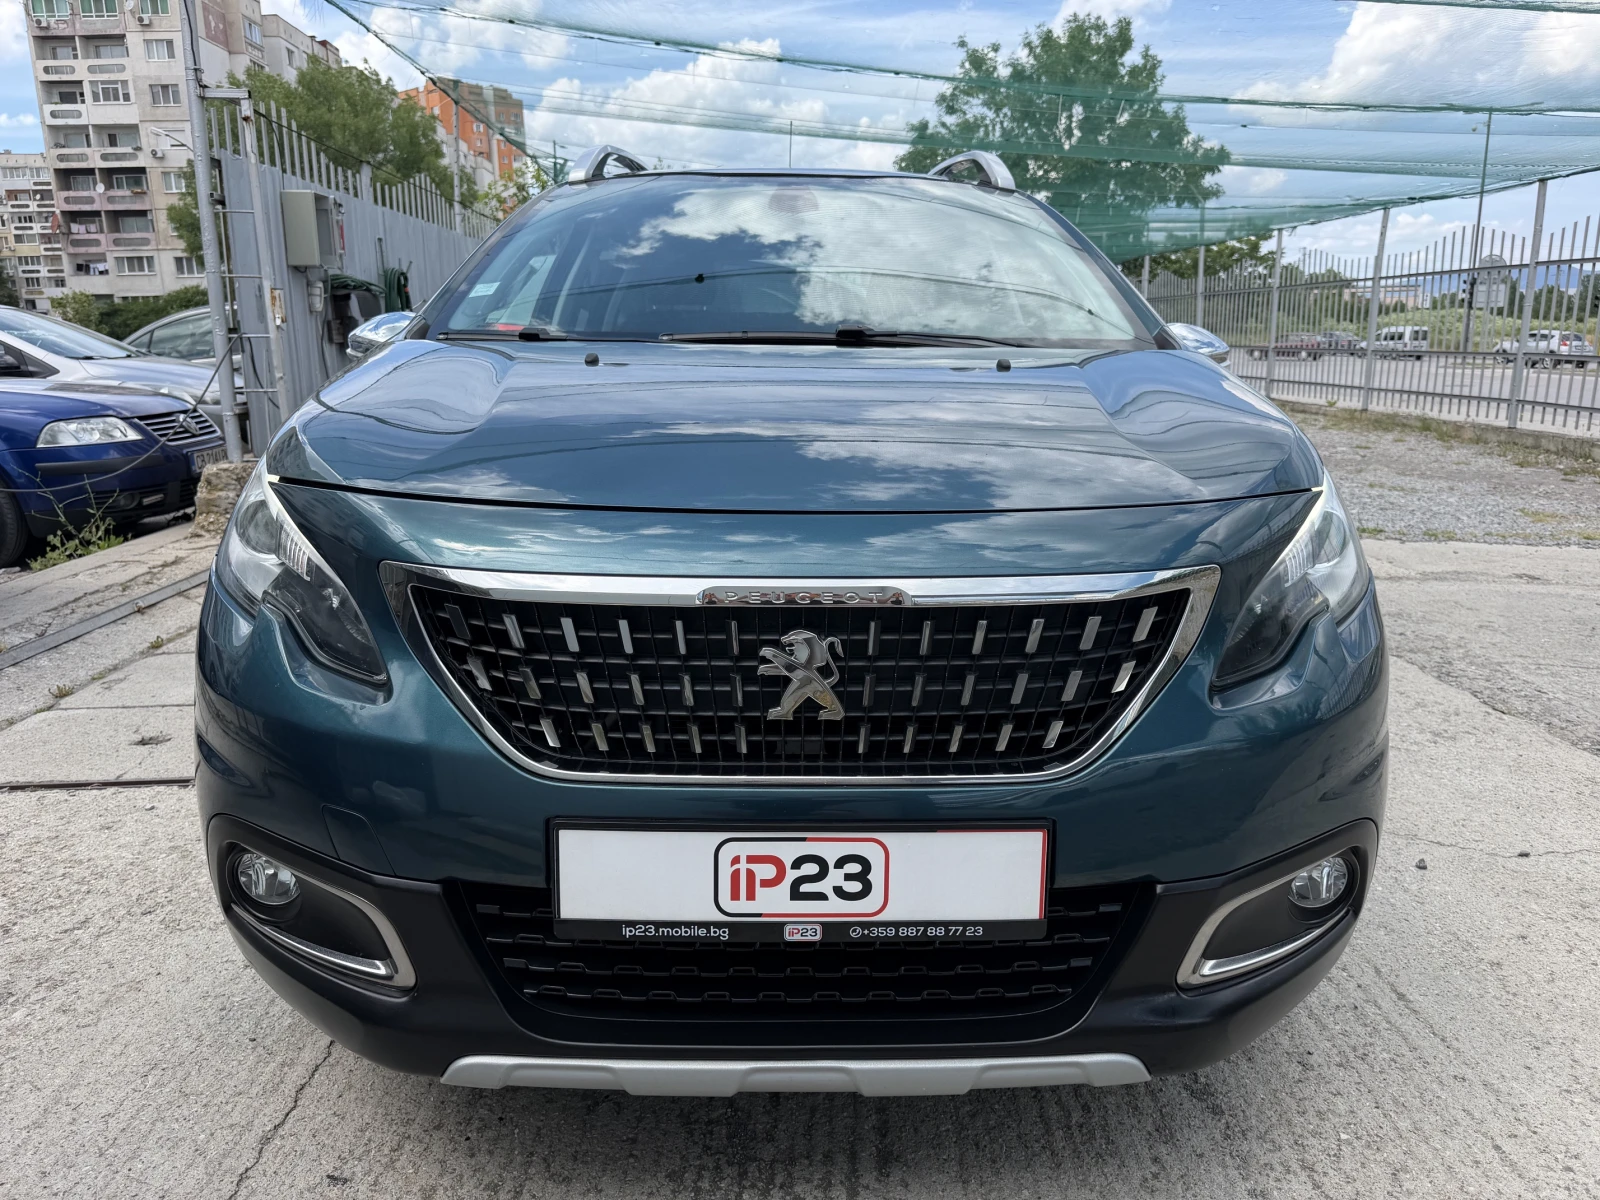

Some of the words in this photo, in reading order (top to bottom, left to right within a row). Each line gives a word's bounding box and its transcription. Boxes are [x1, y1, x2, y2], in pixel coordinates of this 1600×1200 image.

[724, 591, 883, 603] PEUGEOT
[730, 854, 873, 901] iP23
[622, 924, 729, 940] ip23.mobile.bg
[862, 926, 895, 937] +359
[898, 926, 924, 937] 887
[927, 926, 945, 937] 88
[948, 926, 963, 937] 77
[966, 926, 984, 937] 23
